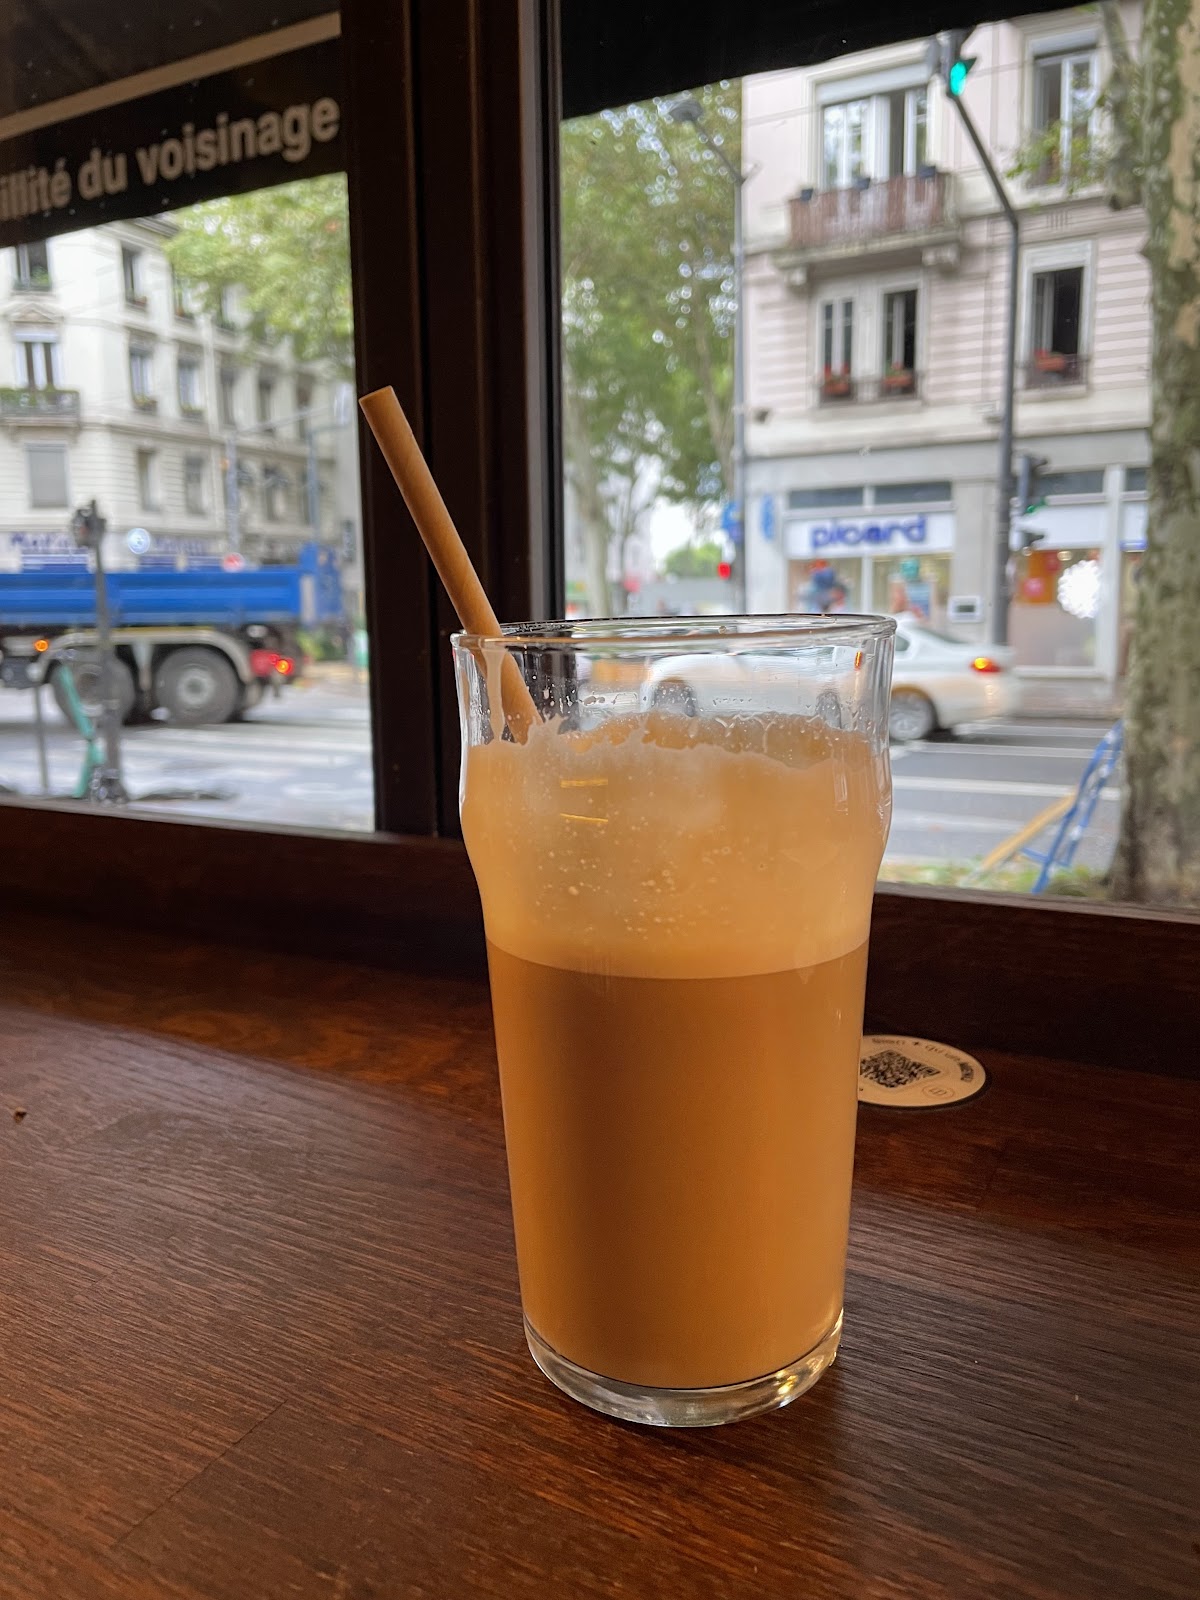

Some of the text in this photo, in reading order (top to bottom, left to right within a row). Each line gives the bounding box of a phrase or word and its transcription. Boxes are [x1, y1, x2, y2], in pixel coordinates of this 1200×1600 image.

[78, 147, 128, 200] du
[135, 97, 341, 186] voisinage
[812, 513, 927, 548] picard
